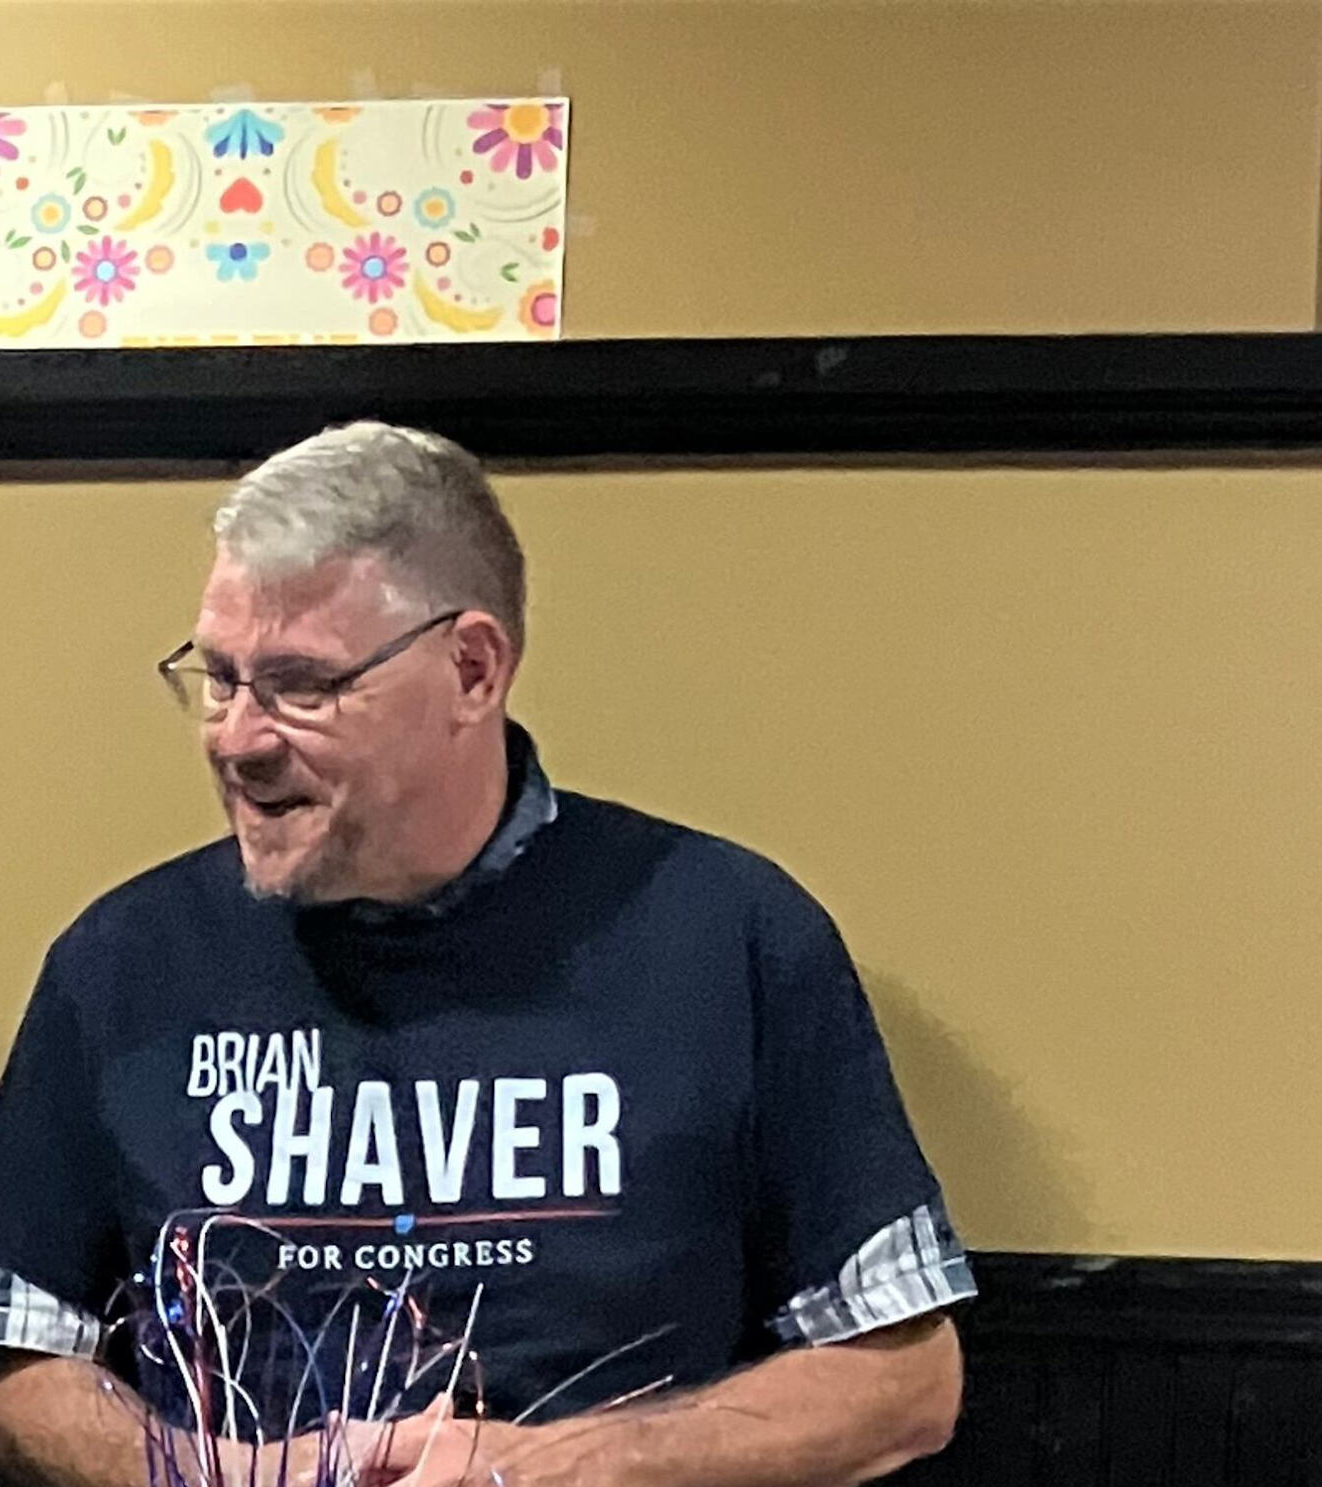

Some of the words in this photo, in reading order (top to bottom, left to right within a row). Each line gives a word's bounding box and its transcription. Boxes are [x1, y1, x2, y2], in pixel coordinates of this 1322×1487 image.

[188, 1029, 320, 1097] BRIAN
[201, 1073, 621, 1205] SHAVER
[277, 1245, 342, 1269] FOR
[355, 1239, 534, 1269] CONGRESS
